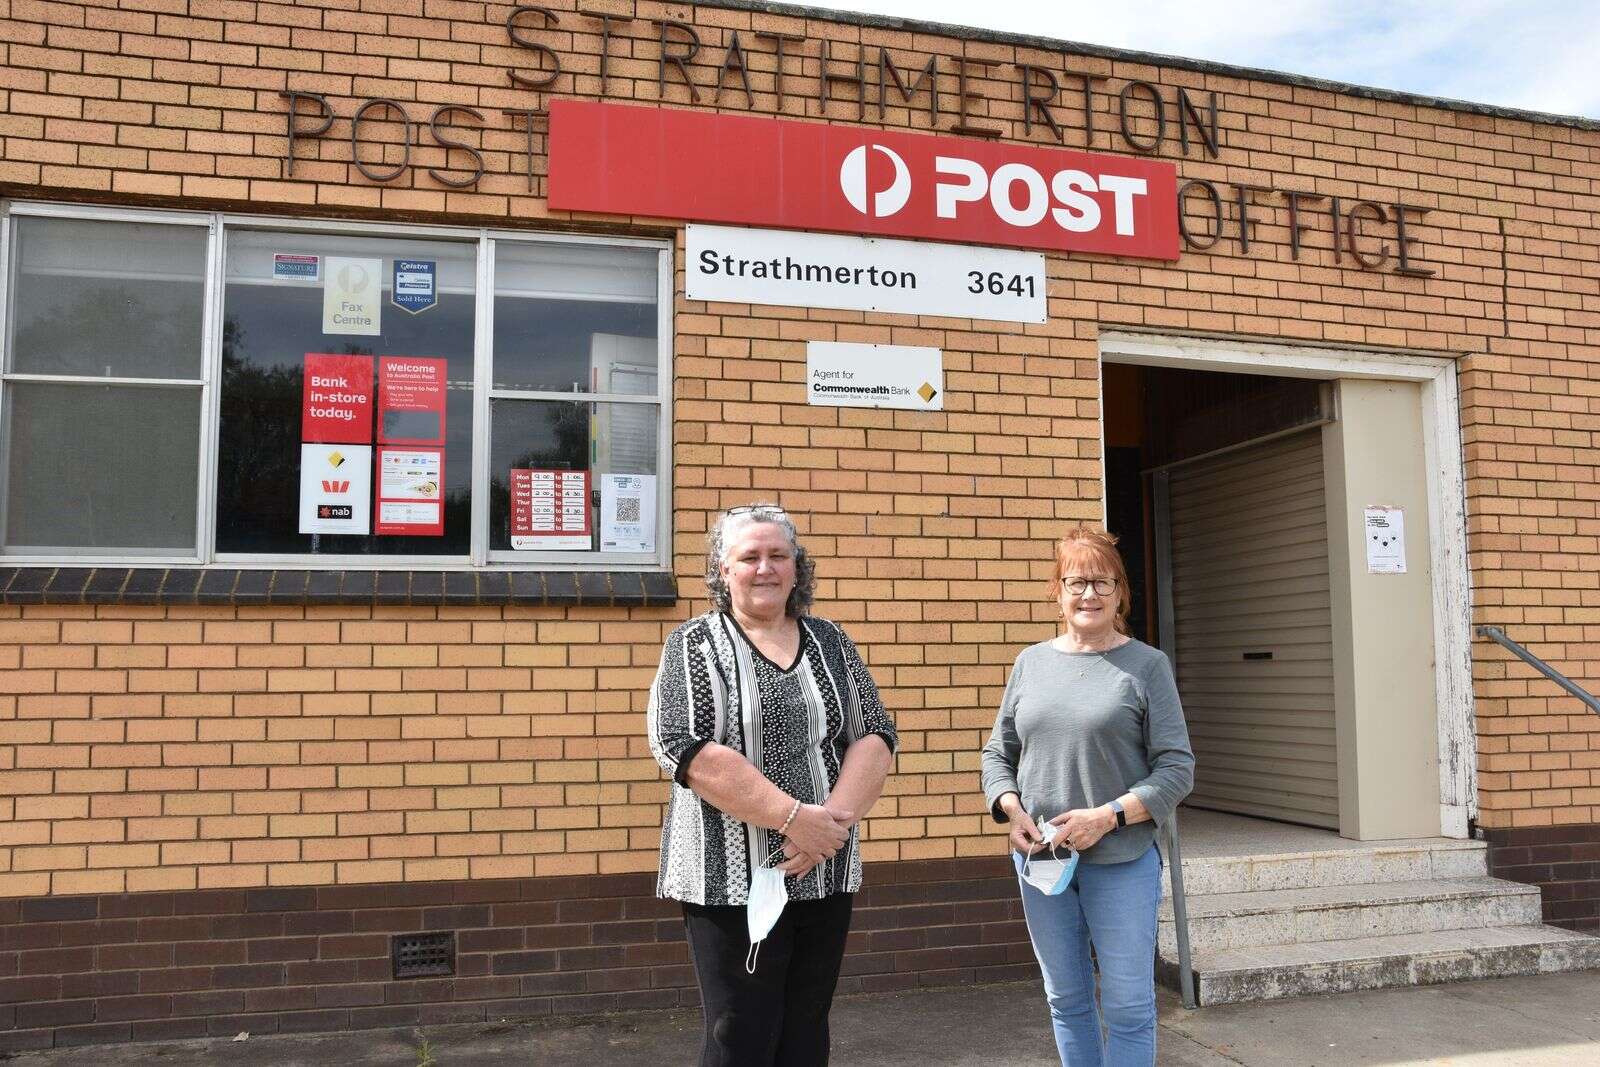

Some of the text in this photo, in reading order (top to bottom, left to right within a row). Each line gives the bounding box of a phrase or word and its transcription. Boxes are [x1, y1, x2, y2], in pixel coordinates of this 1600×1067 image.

[506, 7, 1220, 159] STRATHMERTON
[279, 90, 1435, 279] POST OFFICE
[935, 156, 1148, 237] POST
[699, 249, 1036, 298] Strathmerton 3641
[341, 301, 363, 312] Fax
[333, 314, 371, 326] Centre
[387, 363, 435, 373] Welcome
[813, 369, 854, 380] Agent for
[311, 376, 348, 388] Bank
[813, 383, 910, 396] Commonwealth Bank
[310, 391, 366, 404] in-store
[310, 406, 356, 420] today.
[332, 505, 350, 516] nab
